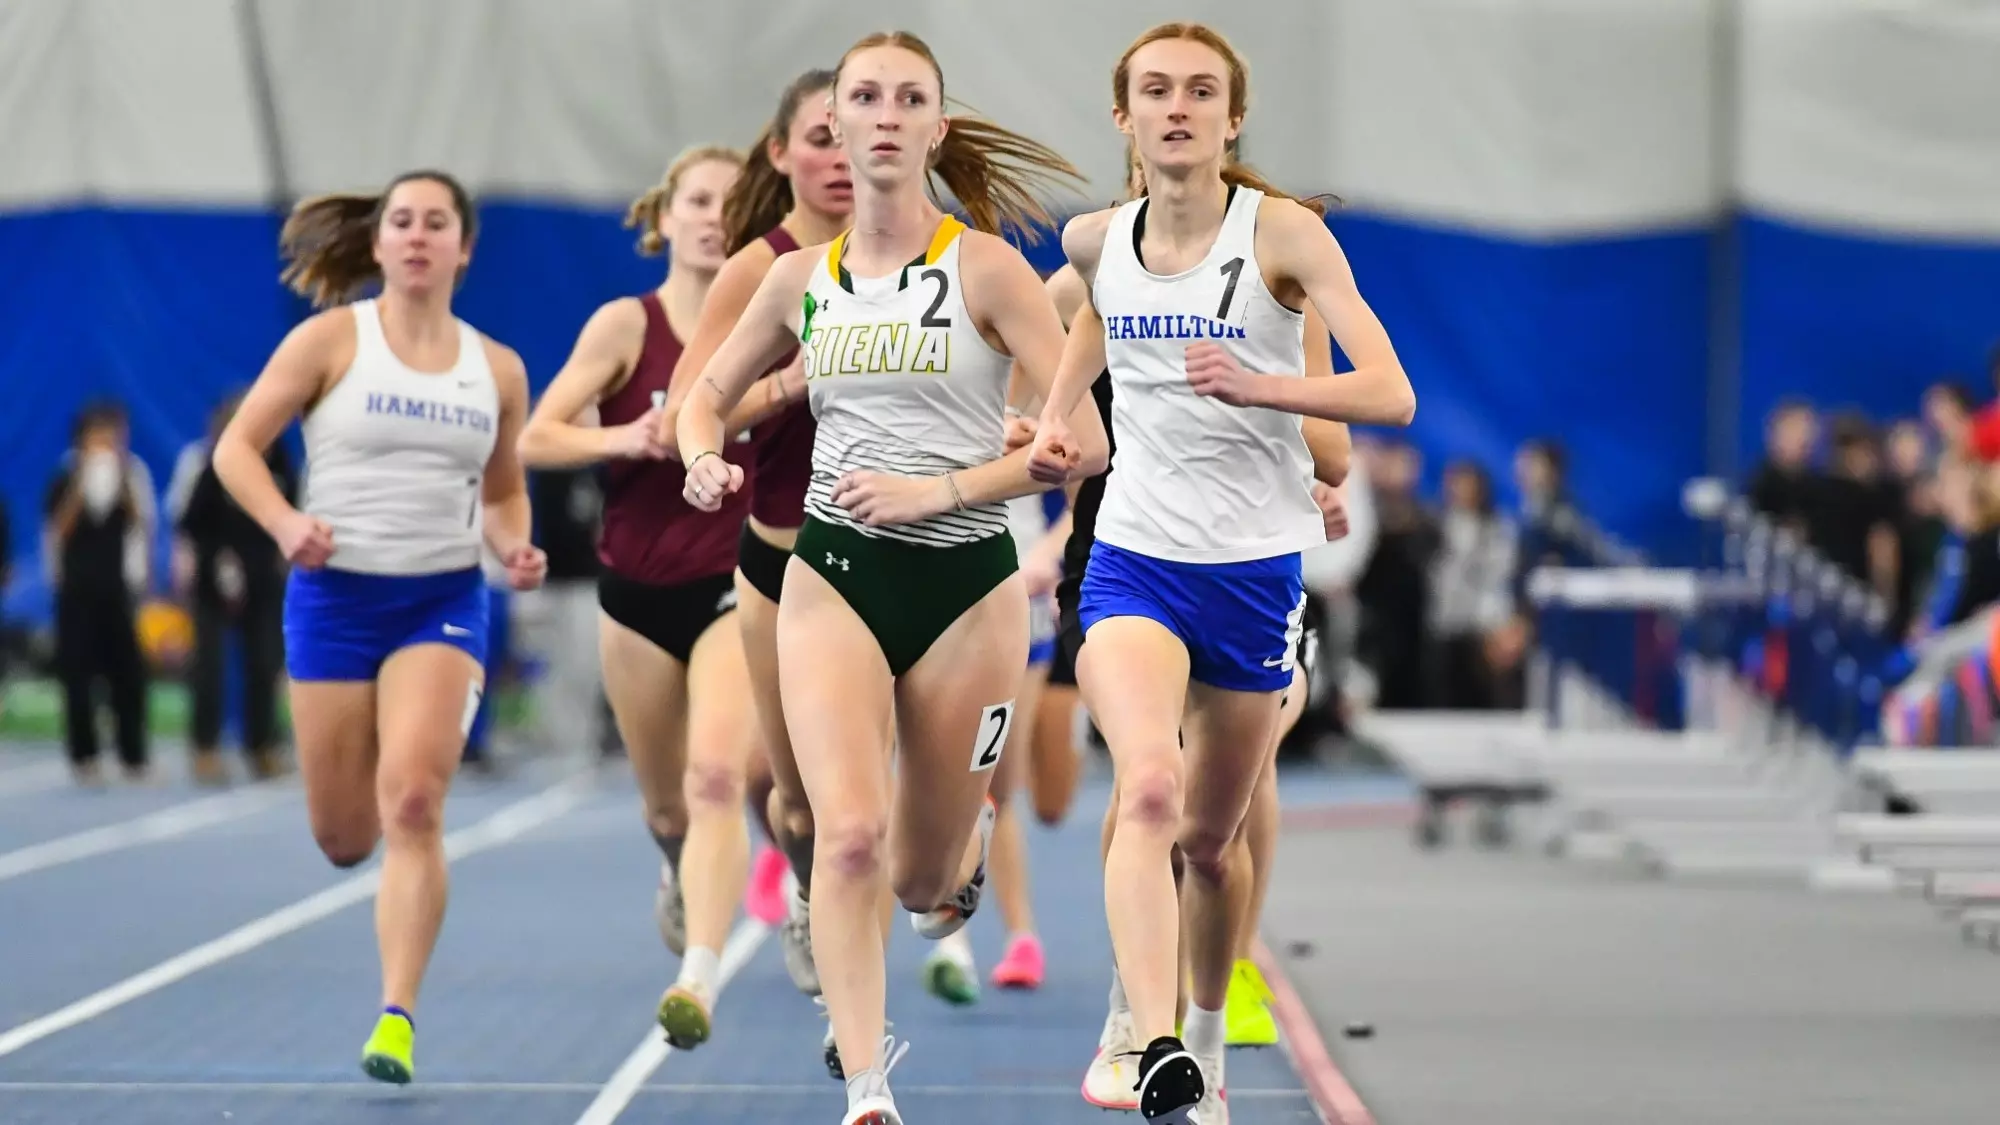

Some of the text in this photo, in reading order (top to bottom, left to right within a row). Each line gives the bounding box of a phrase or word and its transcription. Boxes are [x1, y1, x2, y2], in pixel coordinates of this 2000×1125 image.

[920, 268, 951, 328] 2
[1216, 256, 1245, 320] 1
[803, 322, 949, 380] SIENA
[1107, 314, 1246, 340] HAMILTON
[979, 707, 1007, 767] 2
